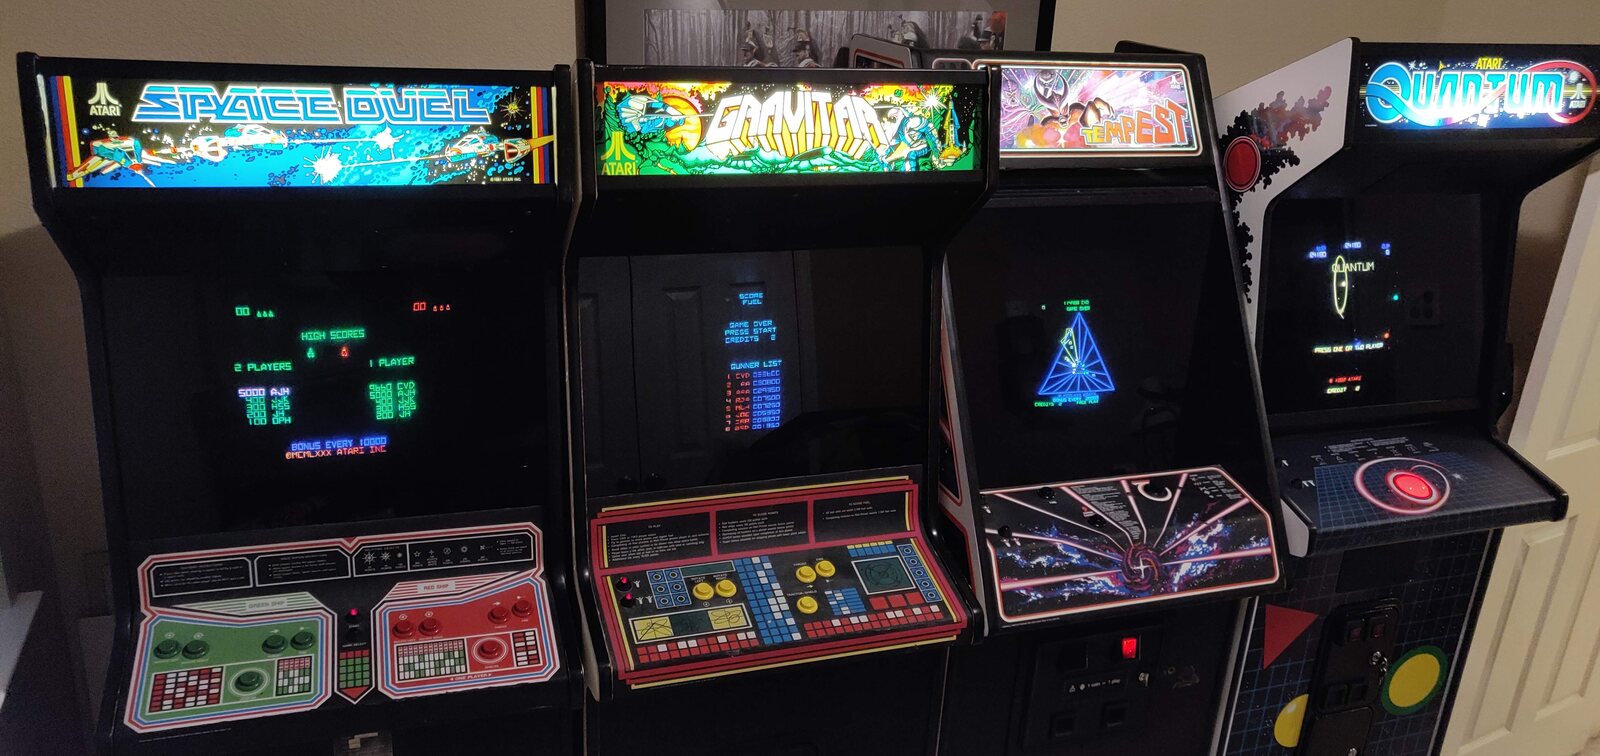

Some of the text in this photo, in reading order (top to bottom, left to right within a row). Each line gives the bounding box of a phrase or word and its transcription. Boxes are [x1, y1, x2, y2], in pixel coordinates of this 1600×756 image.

[1475, 57, 1503, 70] ATARI
[1366, 61, 1568, 127] QUANTUM
[131, 83, 492, 126] SPACE DUEL
[90, 104, 121, 117] ATARI
[705, 91, 892, 160] GRAVITAR
[1082, 99, 1187, 144] TEMPEST
[602, 161, 637, 176] ATARI
[1332, 261, 1375, 273] QUANTUM
[301, 329, 365, 342] HIGH SCORES
[753, 326, 777, 335] START
[725, 335, 759, 344] CREDITS
[234, 362, 292, 372] 2 PLAYERS
[379, 356, 415, 367] PLAYER
[730, 359, 782, 370] GUNNER LIST
[397, 382, 415, 391] CVD
[238, 387, 290, 398] 5000 AJH
[369, 389, 416, 399] 5000 AJH
[245, 396, 265, 404] 400
[246, 403, 266, 411] 300
[376, 404, 394, 412] 300
[246, 410, 285, 419] 200 JH
[376, 410, 411, 420] 200 JH
[249, 417, 267, 426] 100
[291, 436, 387, 452] BONUS EVERY 10000
[336, 446, 364, 456] ATARI
[369, 445, 386, 454] INC
